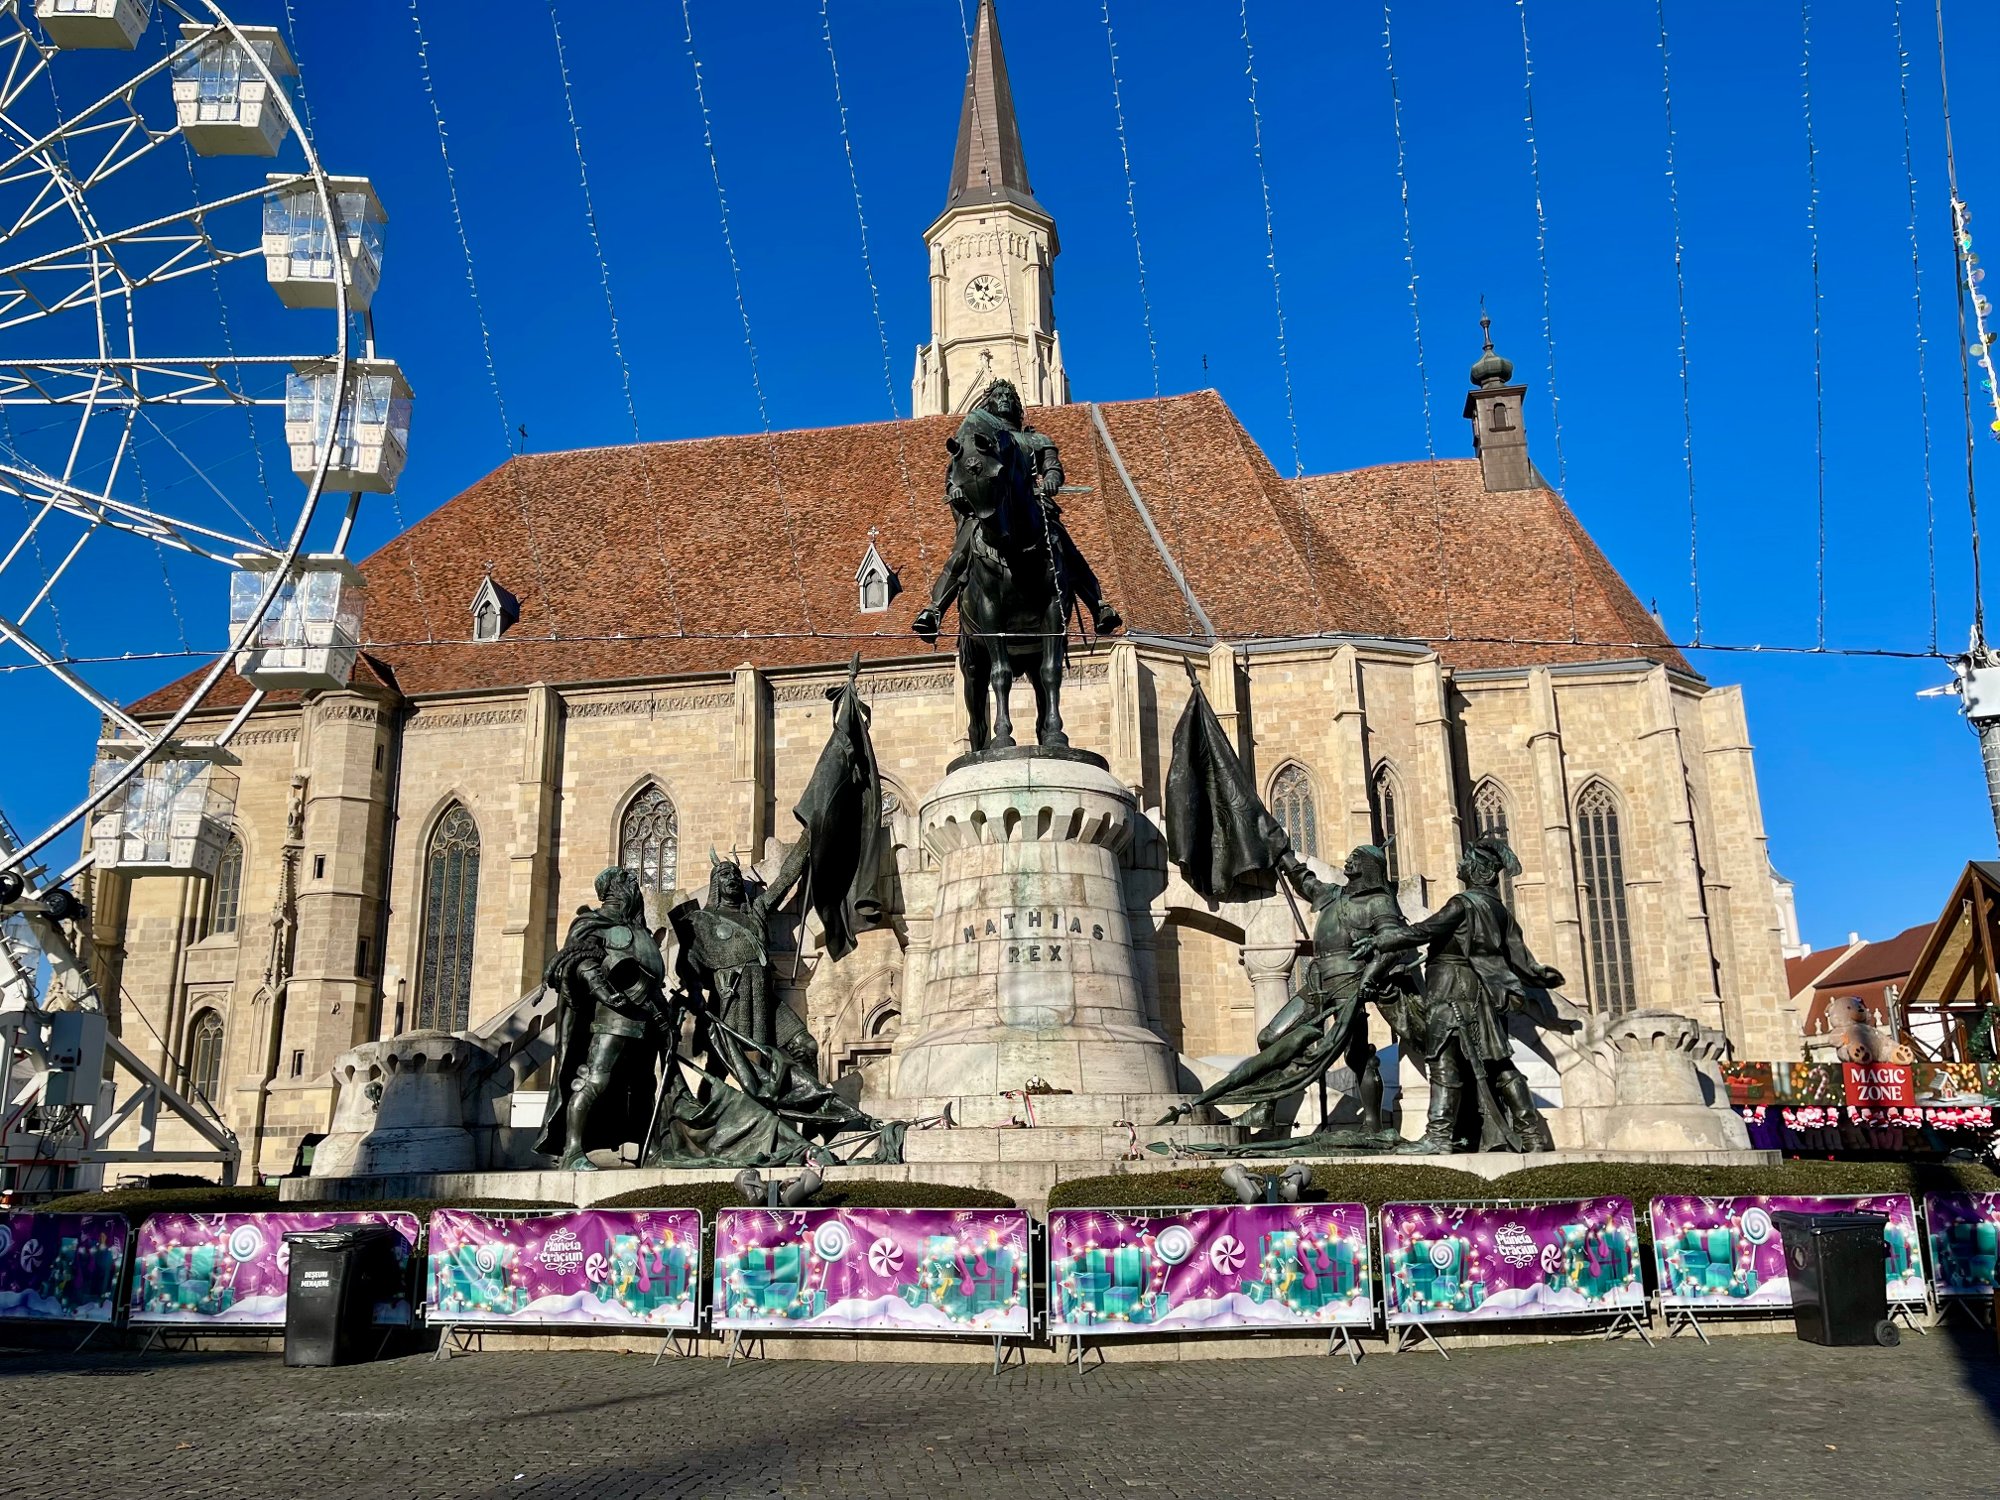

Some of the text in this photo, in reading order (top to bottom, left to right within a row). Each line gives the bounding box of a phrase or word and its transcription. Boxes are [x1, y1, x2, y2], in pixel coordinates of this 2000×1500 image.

[963, 911, 1104, 943] MATHIAS
[1008, 945, 1062, 963] REX
[1851, 1068, 1906, 1083] MAGIC
[1857, 1085, 1903, 1101] ZONE
[543, 1239, 581, 1252] Planeta
